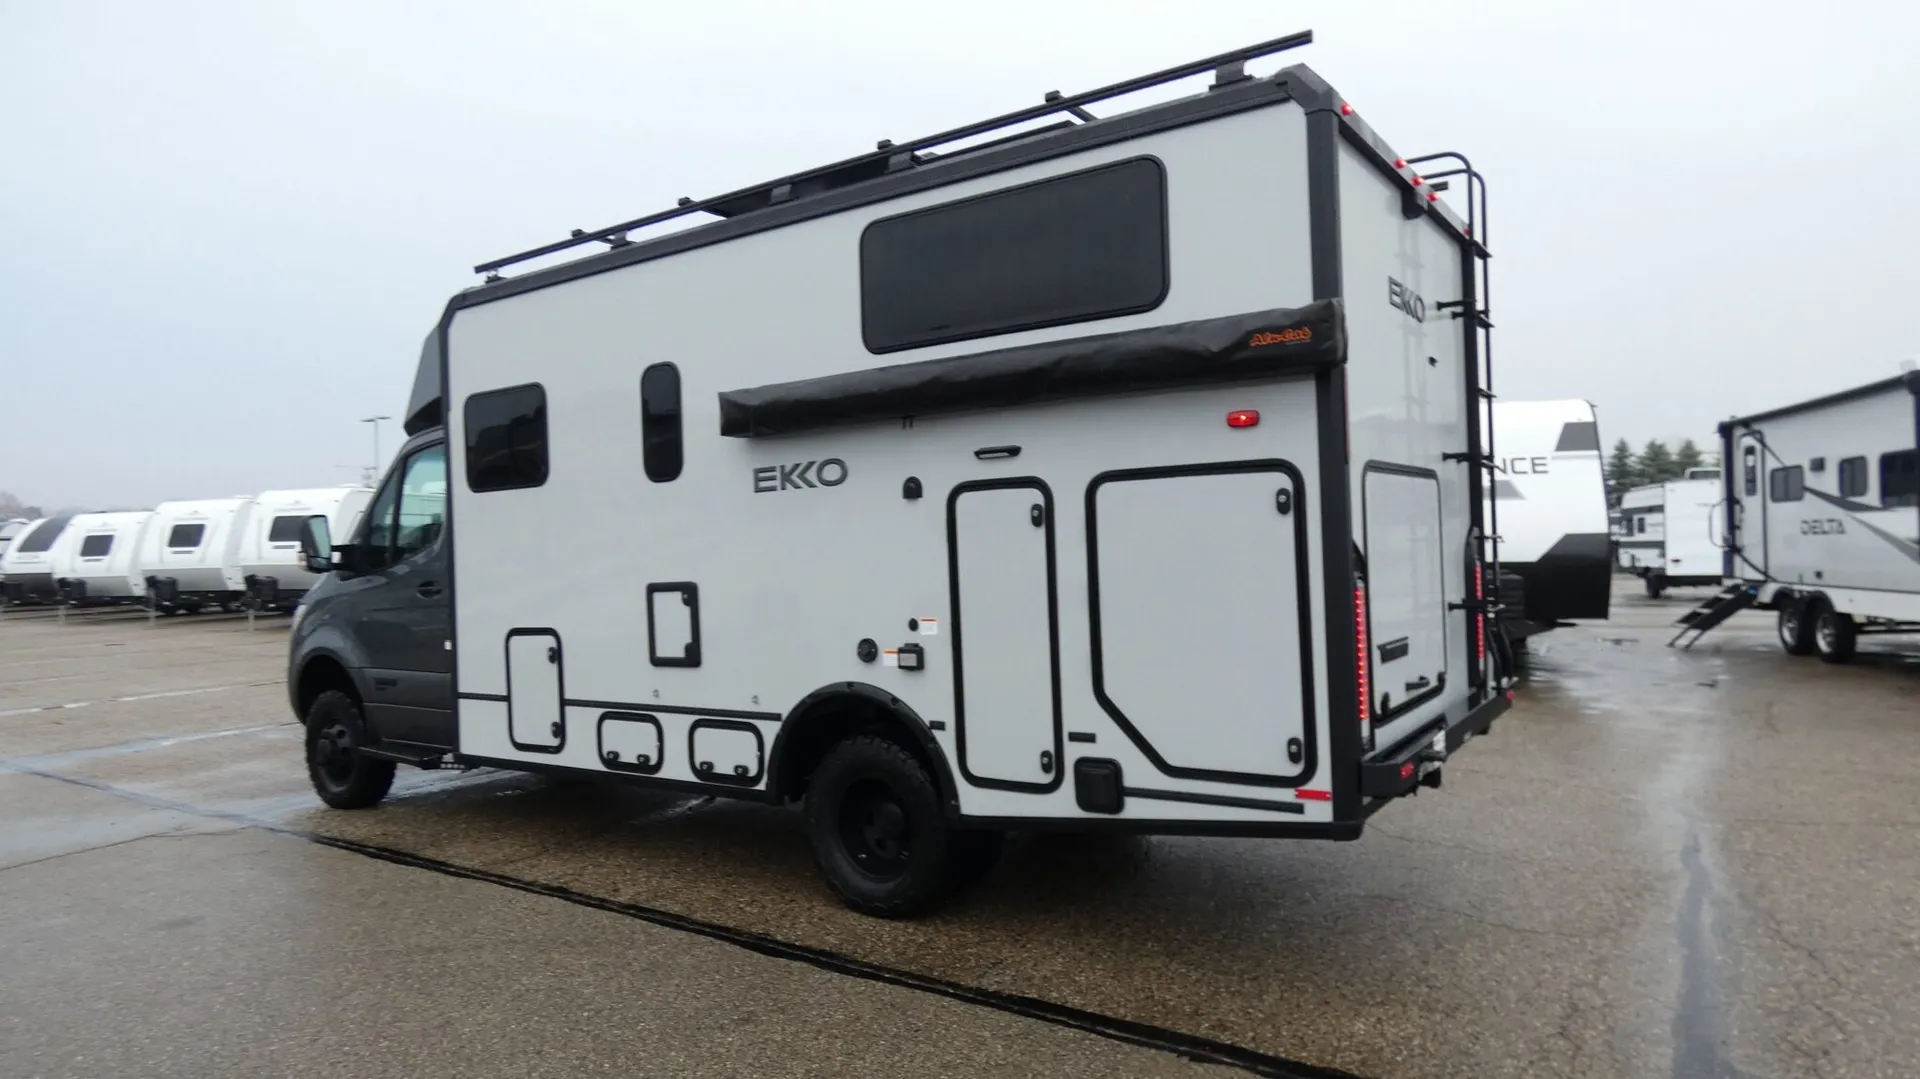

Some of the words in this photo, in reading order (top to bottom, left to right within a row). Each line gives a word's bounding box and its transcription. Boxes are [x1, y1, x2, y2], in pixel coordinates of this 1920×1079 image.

[1388, 275, 1425, 323] EKKO
[753, 457, 849, 493] EKKO
[1800, 518, 1846, 535] DELTA
